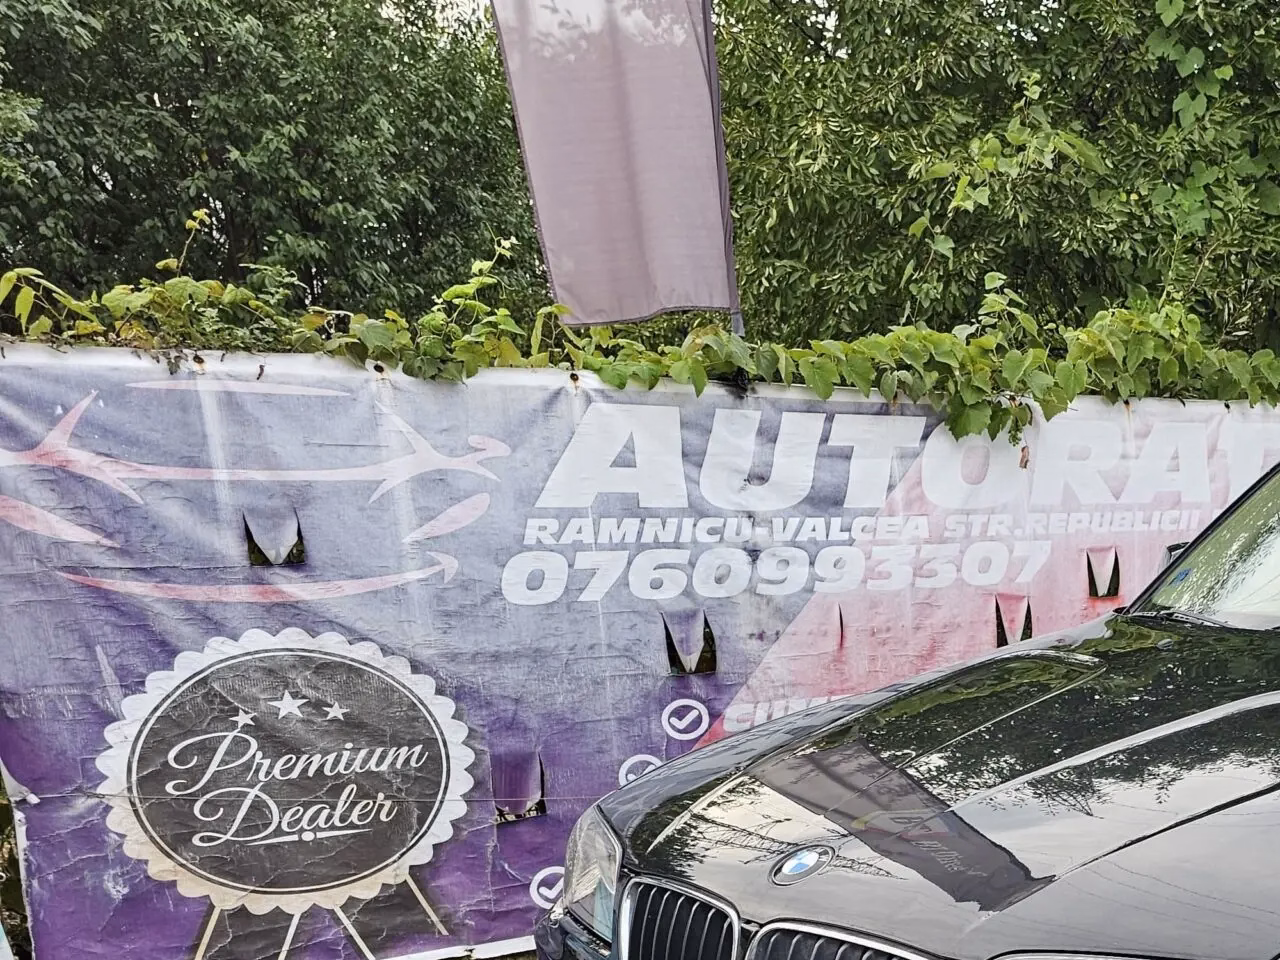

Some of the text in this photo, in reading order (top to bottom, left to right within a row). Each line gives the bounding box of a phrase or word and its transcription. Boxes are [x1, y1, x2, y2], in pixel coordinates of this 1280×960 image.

[523, 516, 930, 545] RAMNICU-VALCEA
[501, 540, 1052, 599] 0760993307
[165, 729, 429, 795] Premium
[192, 782, 398, 847] Dealer
